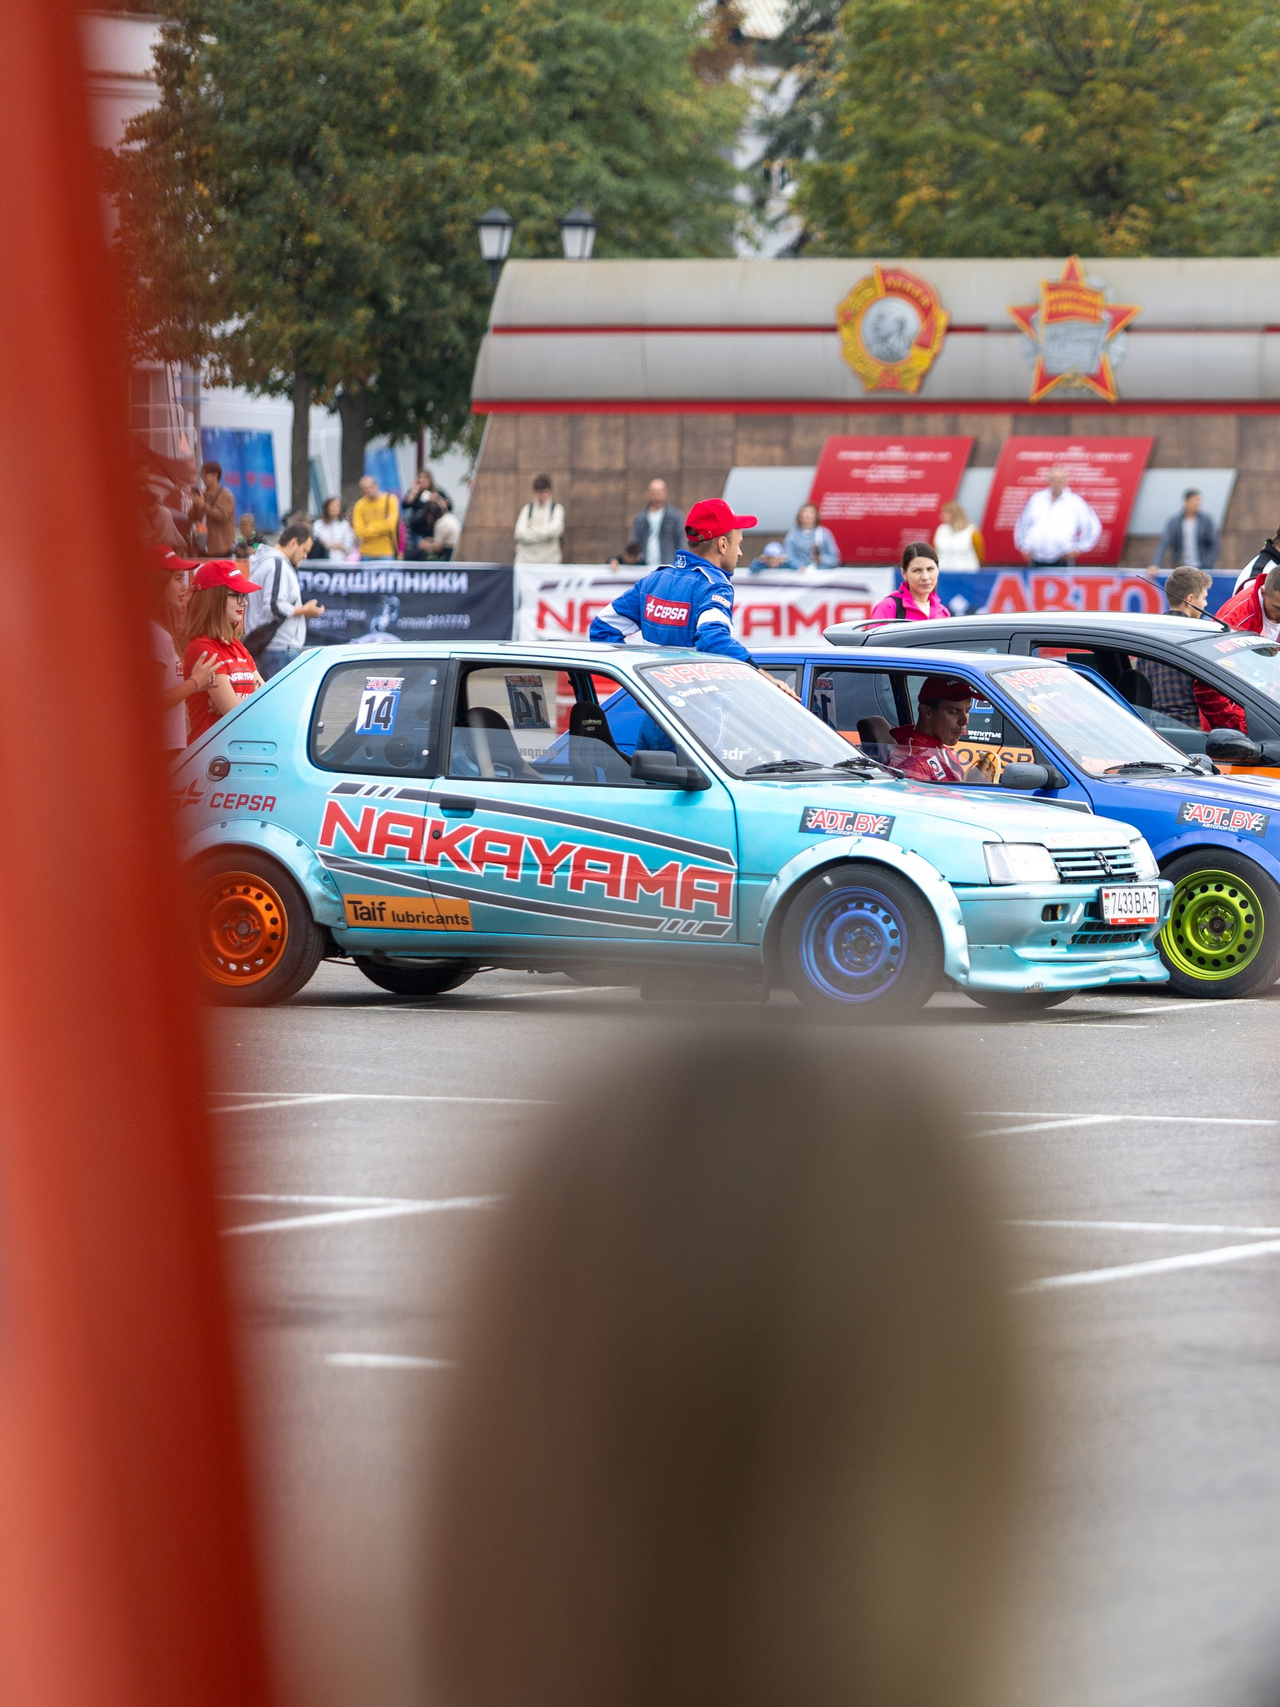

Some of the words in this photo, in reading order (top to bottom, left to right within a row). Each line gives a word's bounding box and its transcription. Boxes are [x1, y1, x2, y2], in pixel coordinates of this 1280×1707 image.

[654, 604, 688, 621] CEPSA
[364, 695, 395, 730] 14
[209, 791, 277, 813] CEPSA
[808, 808, 884, 834] ADT.BY
[1186, 803, 1260, 831] ADT.BY
[1202, 823, 1239, 833] АВТОПОРТАЛ
[317, 799, 735, 919] NAKAYAMA
[347, 900, 386, 922] Taif
[391, 910, 470, 926] lubricants
